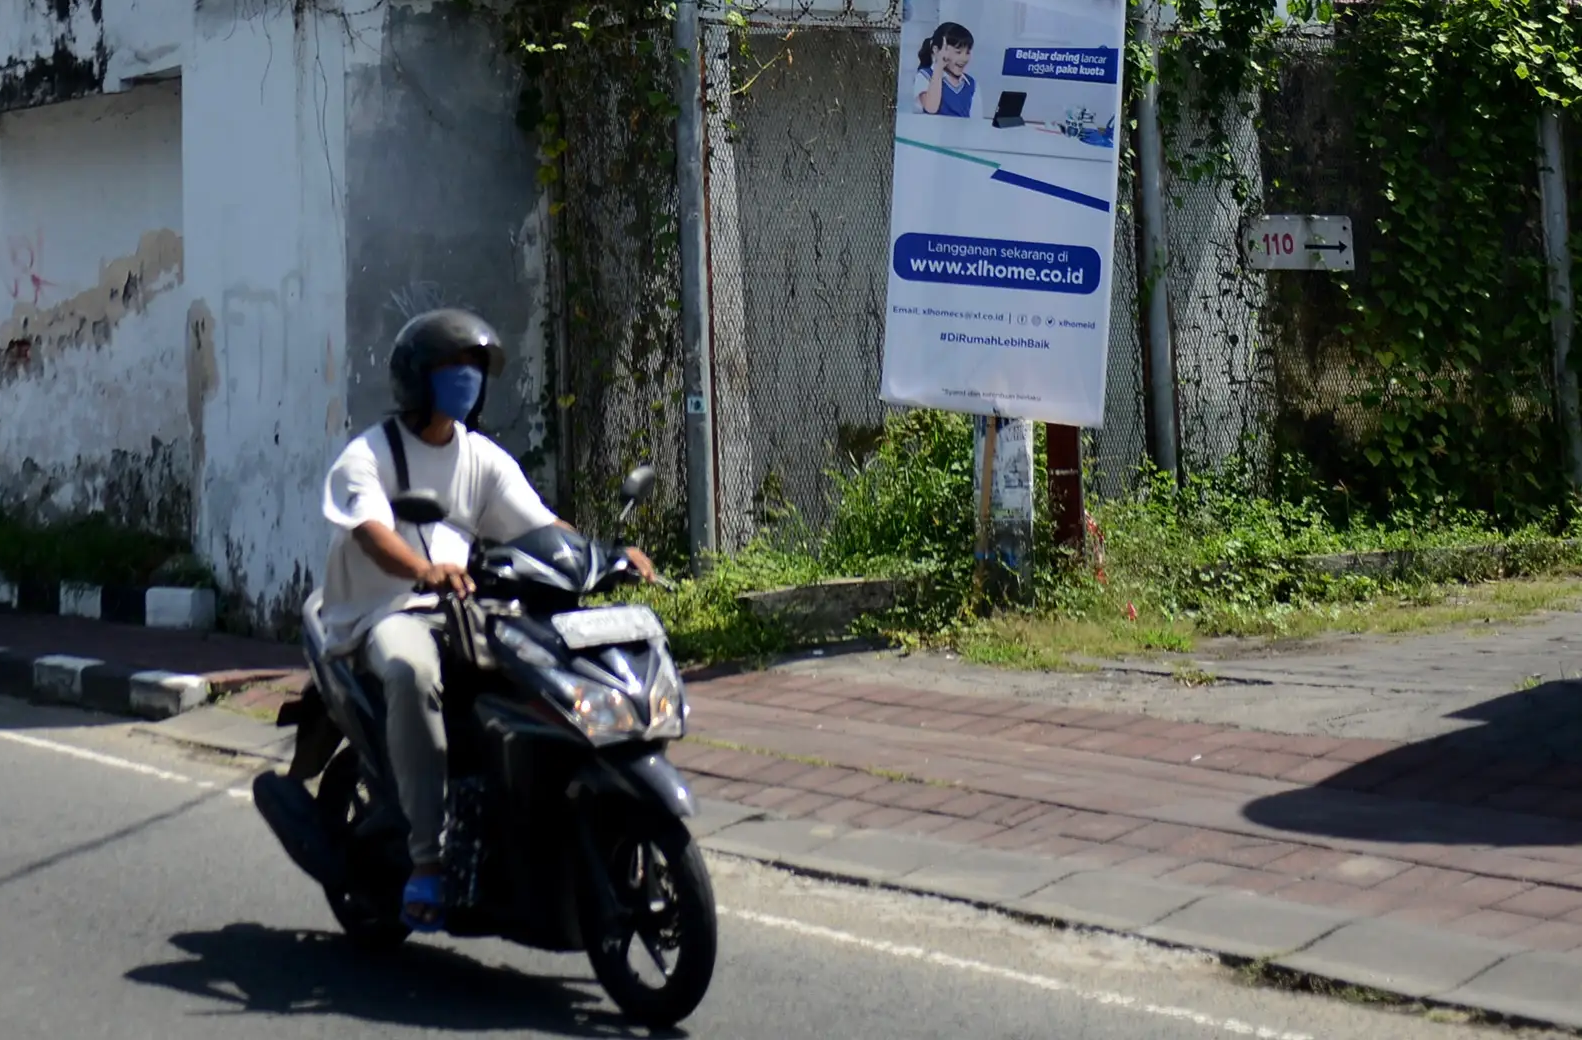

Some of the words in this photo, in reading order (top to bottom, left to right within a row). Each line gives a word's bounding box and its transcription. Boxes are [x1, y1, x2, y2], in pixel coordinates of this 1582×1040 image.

[1015, 49, 1051, 62] Belajar
[1050, 51, 1080, 64] daring
[1081, 53, 1107, 64] lancar
[1027, 63, 1055, 74] nggak
[1055, 65, 1078, 76] pake
[1079, 66, 1105, 76] kuota
[927, 240, 997, 257] Langganan
[1000, 247, 1055, 263] sekarang
[1057, 250, 1069, 262] di
[1263, 233, 1294, 256] 110
[910, 258, 1084, 285] www.xlhome.co.id
[939, 332, 1051, 350] #DiRumahLebihBaik
